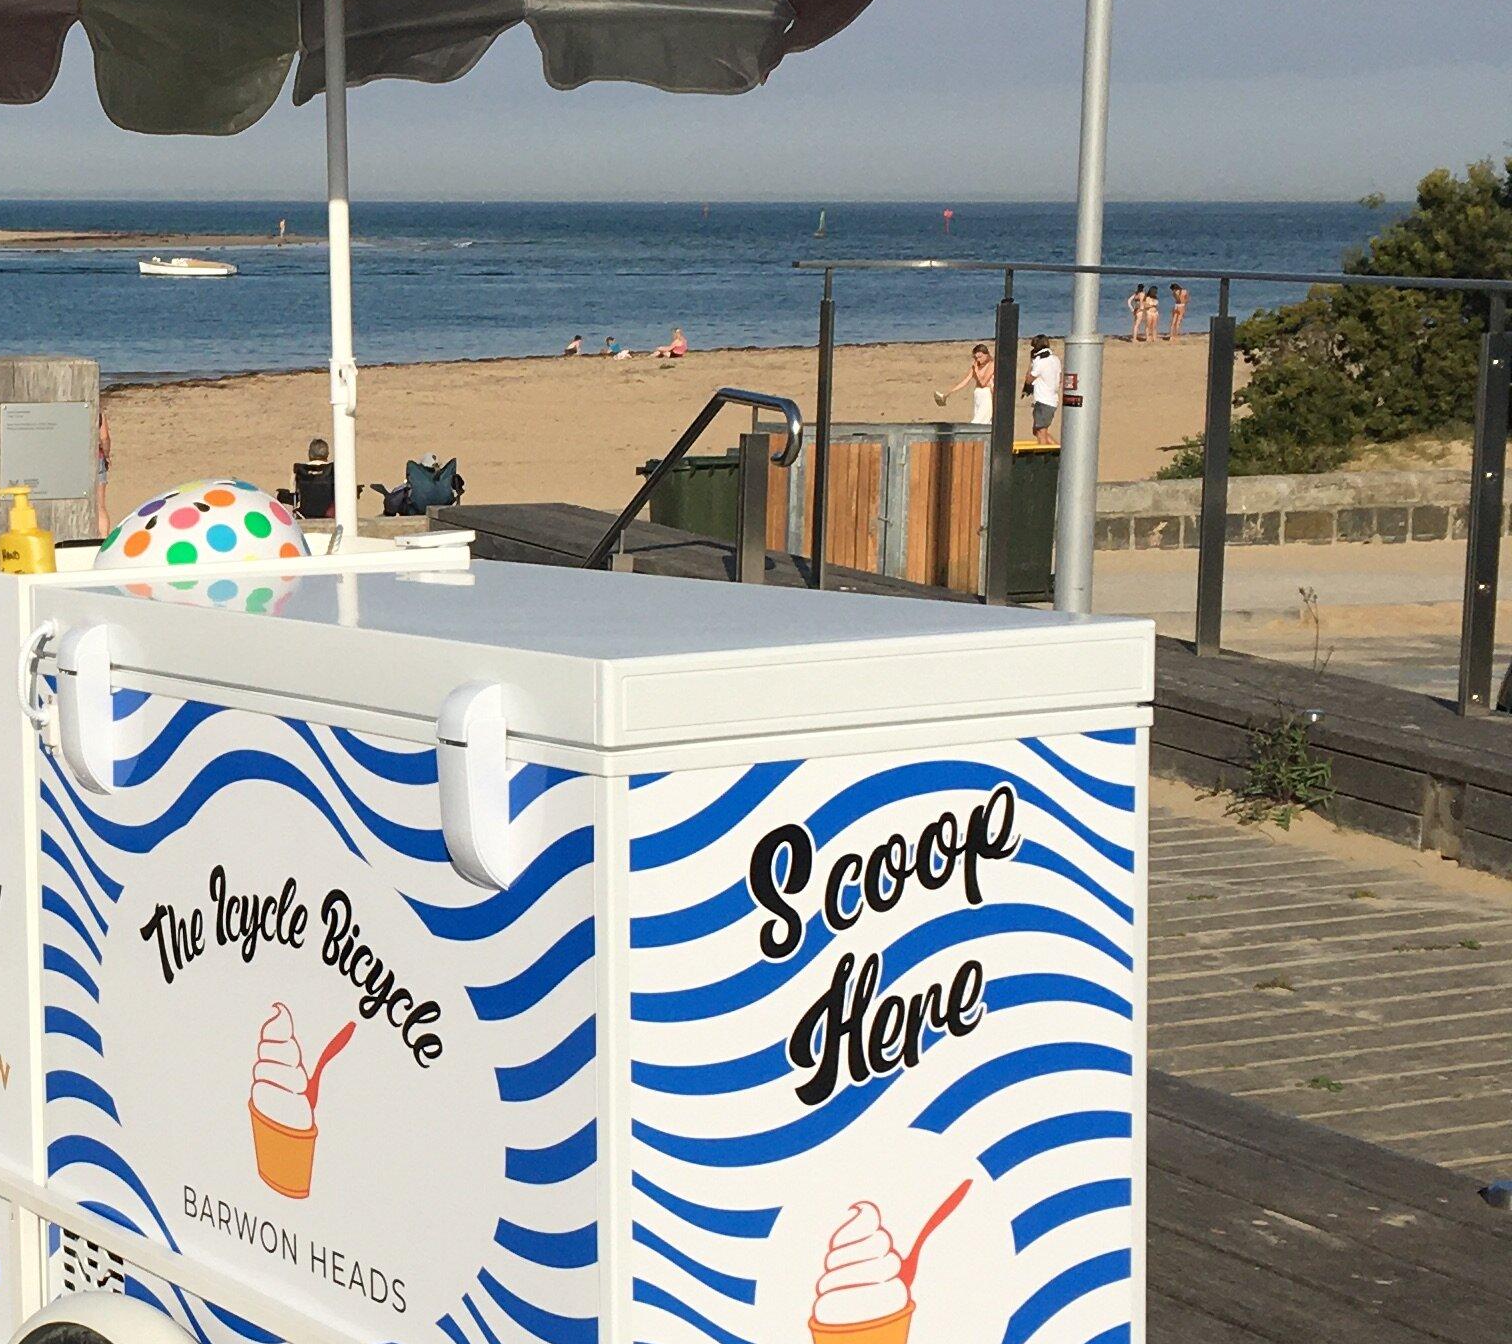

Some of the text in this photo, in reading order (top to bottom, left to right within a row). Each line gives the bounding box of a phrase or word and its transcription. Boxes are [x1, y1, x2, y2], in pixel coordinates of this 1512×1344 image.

[749, 785, 1019, 959] Scoop
[140, 864, 444, 1069] The Icycle Bicycle
[789, 953, 983, 1105] Here
[183, 1185, 407, 1314] BARWON HEADS
